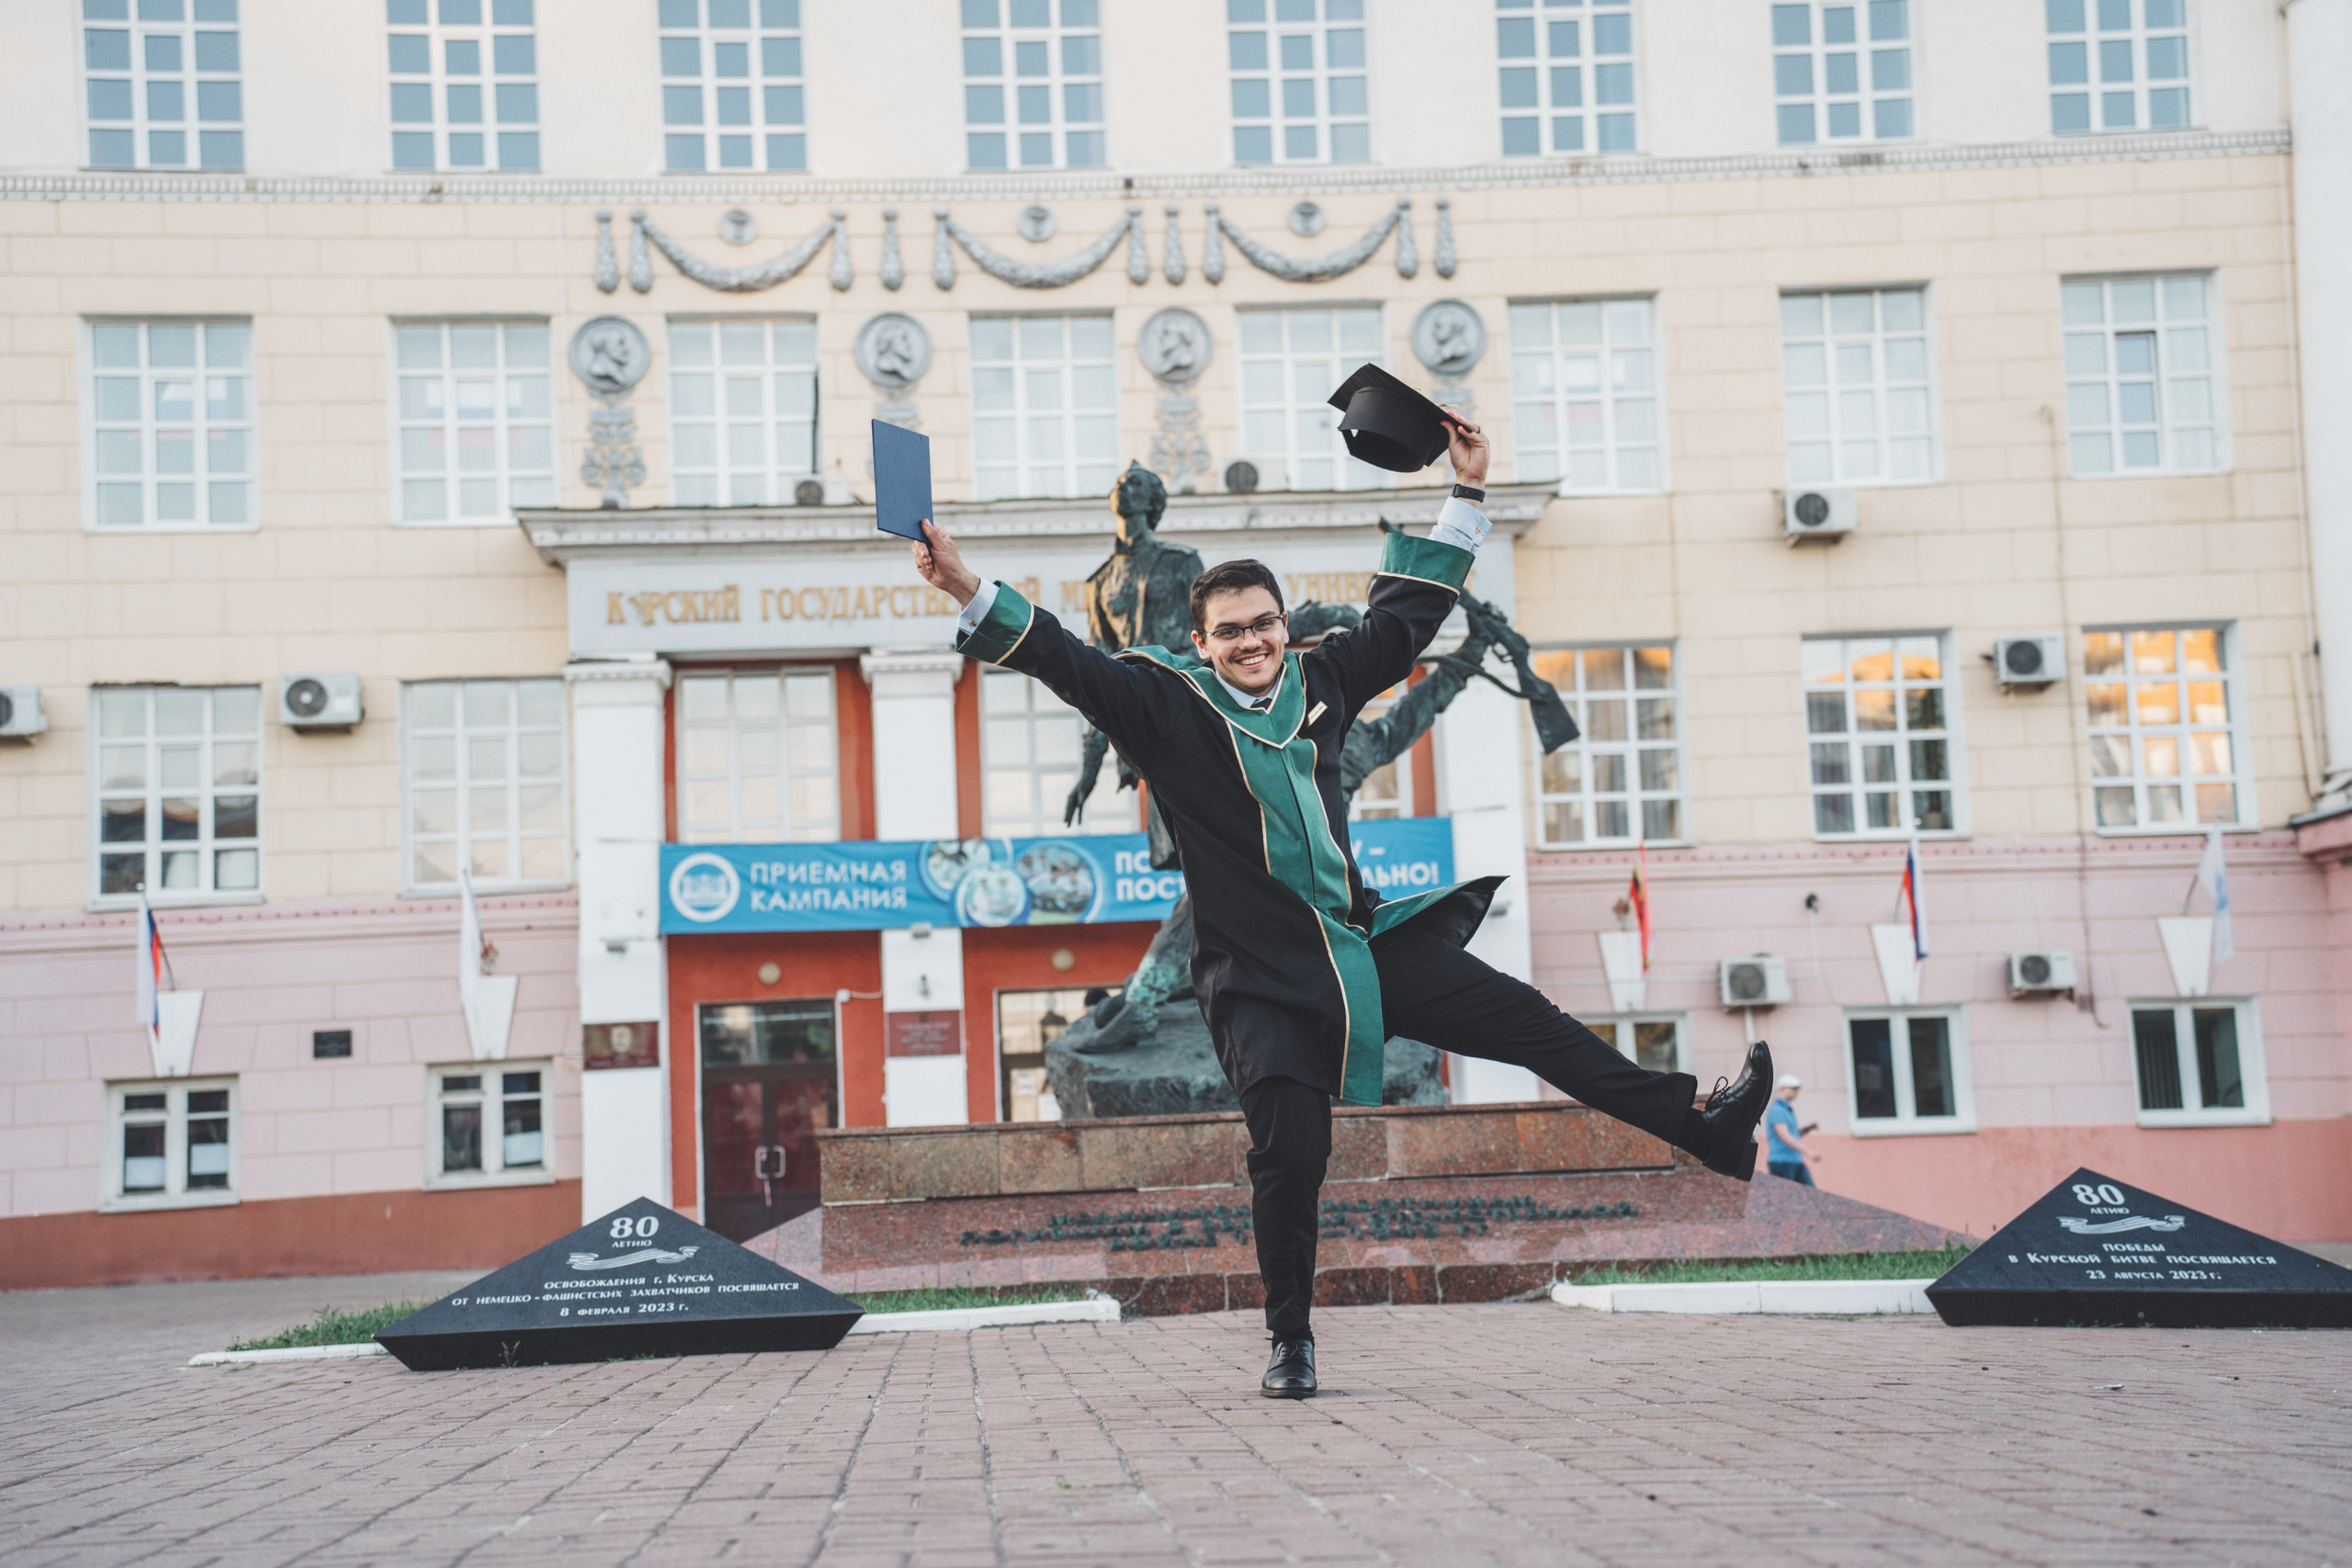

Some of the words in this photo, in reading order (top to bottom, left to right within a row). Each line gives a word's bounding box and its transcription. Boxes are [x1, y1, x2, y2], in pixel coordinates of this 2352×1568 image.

[750, 860, 907, 885] ПРИЕМНАЯ
[750, 886, 907, 911] КАМПАНИЯ
[2072, 1184, 2125, 1205] 80
[609, 1215, 660, 1239] 80
[611, 1239, 652, 1248] ЛЕТИЮ
[2102, 1243, 2165, 1252] ПОБЕДЫ
[2109, 1255, 2157, 1264] БИТВЕ
[2086, 1269, 2107, 1280] 23
[2114, 1271, 2165, 1280] АВГУСТА
[2171, 1269, 2208, 1280] 2023
[543, 1277, 646, 1290] ОСВОБОЖДЕНИЯ
[451, 1297, 469, 1306] ОТ
[629, 1285, 711, 1297] ЗАХВАТЧИКОВ
[560, 1307, 570, 1317] 8
[577, 1306, 630, 1316] ФЕВРАЛЯ
[638, 1302, 675, 1314] 2023
